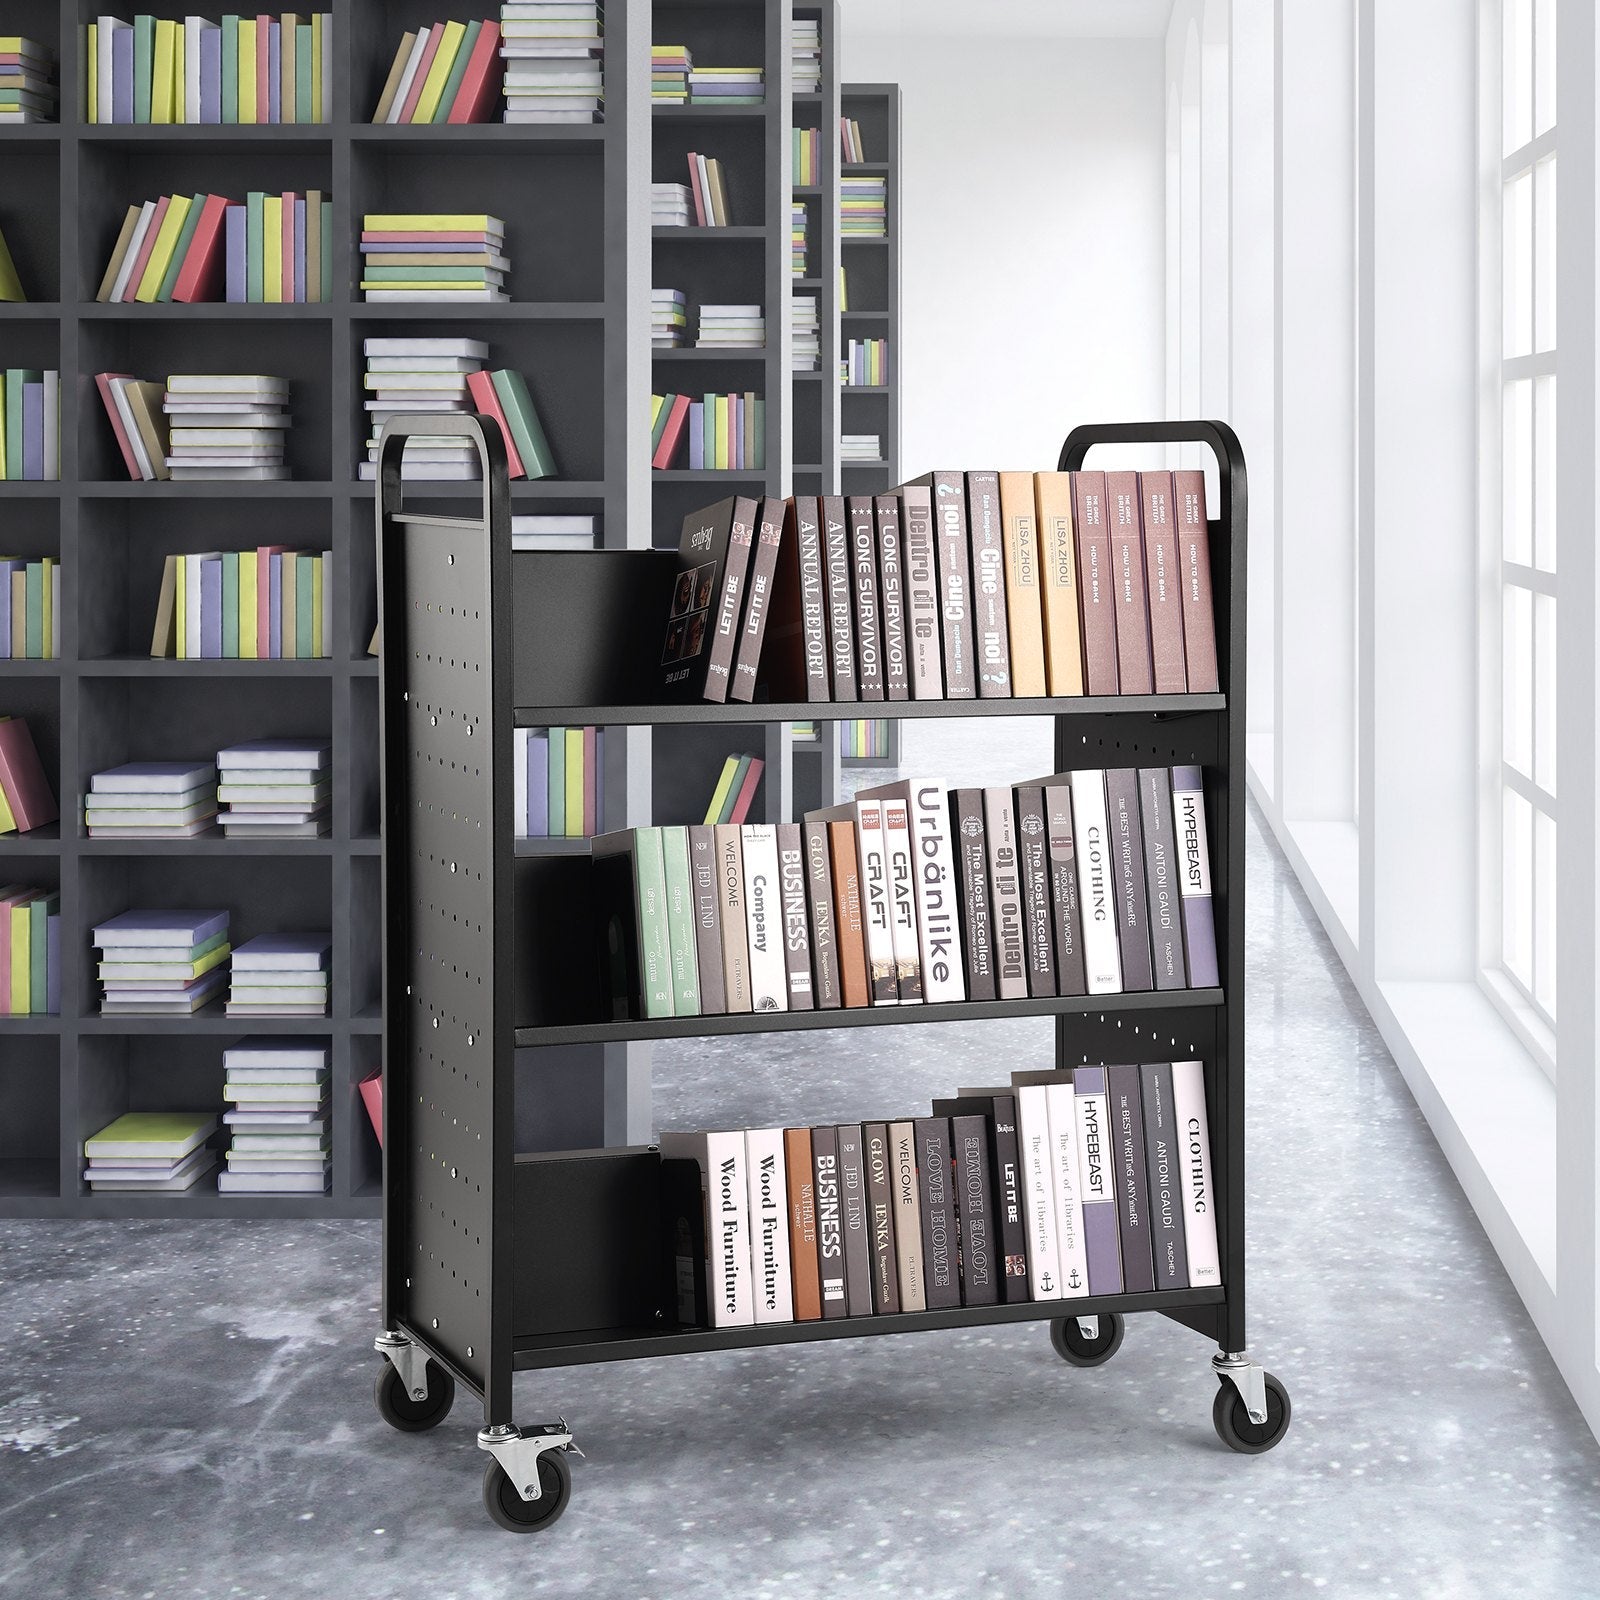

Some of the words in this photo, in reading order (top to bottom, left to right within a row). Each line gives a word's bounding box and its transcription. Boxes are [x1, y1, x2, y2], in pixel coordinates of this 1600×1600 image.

[937, 484, 961, 497] ?
[940, 505, 960, 537] noi
[1019, 520, 1029, 547] LISA
[1056, 520, 1067, 547] LISA
[800, 520, 820, 598] ANNUAL
[828, 520, 848, 598] ANNUAL
[856, 525, 872, 574] LONE
[882, 525, 898, 574] LONE
[909, 506, 930, 582] Dentro
[728, 575, 739, 594] BE
[756, 575, 767, 594] BE
[980, 548, 1000, 594] Cine
[1020, 550, 1031, 583] ZHOU
[1058, 550, 1068, 583] ZHOU
[1092, 568, 1098, 578] TO
[1124, 568, 1130, 578] TO
[1158, 568, 1164, 577] TO
[1191, 568, 1198, 576] TO
[726, 597, 736, 611] IT
[754, 597, 764, 611] IT
[913, 590, 934, 610] di
[945, 575, 964, 620] Cine
[720, 610, 734, 635] LET
[748, 610, 762, 635] LET
[805, 602, 824, 678] REPORT
[833, 602, 852, 678] REPORT
[858, 578, 877, 676] SURVIVOR
[885, 578, 903, 676] SURVIVOR
[915, 617, 934, 638] te
[984, 632, 1005, 664] noi
[982, 672, 1007, 685] ?
[1120, 812, 1129, 838] BEST
[1182, 797, 1202, 889] HYPEBEAST
[971, 844, 982, 870] The
[996, 847, 1014, 868] te
[1032, 842, 1042, 868] The
[1154, 843, 1166, 888] ANTONI
[696, 864, 710, 887] JED
[726, 840, 738, 907] WELCOME
[868, 852, 886, 928] CRAFT
[892, 852, 911, 928] CRAFT
[918, 787, 952, 983] Urbänlike
[974, 873, 985, 908] Most
[996, 876, 1016, 895] di
[1034, 872, 1044, 905] Most
[1088, 826, 1106, 922] CLOTHING
[647, 888, 656, 915] design
[674, 886, 682, 914] design
[701, 896, 714, 929] LIND
[753, 874, 767, 952] Company
[782, 850, 807, 952] BUSINESS
[847, 874, 861, 932] NATHALIE
[1060, 866, 1068, 902] AROUND
[1064, 923, 1072, 955] WORLD
[1158, 891, 1173, 929] GAUDÍ
[976, 911, 989, 976] Excellent
[1001, 902, 1022, 979] Dentro
[1036, 909, 1049, 973] Excellent
[1165, 942, 1173, 976] TASCHEN
[1121, 1110, 1132, 1136] BEST
[1032, 1135, 1040, 1156] The
[1060, 1132, 1069, 1153] The
[1084, 1101, 1103, 1194] HYPEBEAST
[760, 1154, 776, 1209] Wood
[844, 1165, 858, 1189] JED
[900, 1138, 913, 1205] WELCOME
[926, 1138, 944, 1204] LOVE
[964, 1137, 984, 1213] HOME
[1004, 1163, 1014, 1188] LET
[1157, 1141, 1170, 1186] ANTONI
[1188, 1118, 1206, 1214] CLOTHING
[720, 1157, 737, 1212] Wood
[1006, 1189, 1016, 1203] IT
[1035, 1181, 1044, 1194] of
[1064, 1178, 1072, 1191] of
[802, 1184, 814, 1242] NATHALIE
[817, 1155, 840, 1258] BUSINESS
[848, 1197, 860, 1230] LIND
[1007, 1208, 1017, 1223] BE
[1064, 1197, 1076, 1250] libraries
[1160, 1190, 1175, 1229] GAUDÍ
[1036, 1200, 1048, 1252] libraries
[762, 1216, 779, 1310] Furniture
[931, 1210, 949, 1287] HOME
[970, 1218, 988, 1286] LOVE
[1167, 1242, 1175, 1276] TASCHEN
[723, 1220, 739, 1314] Furniture
